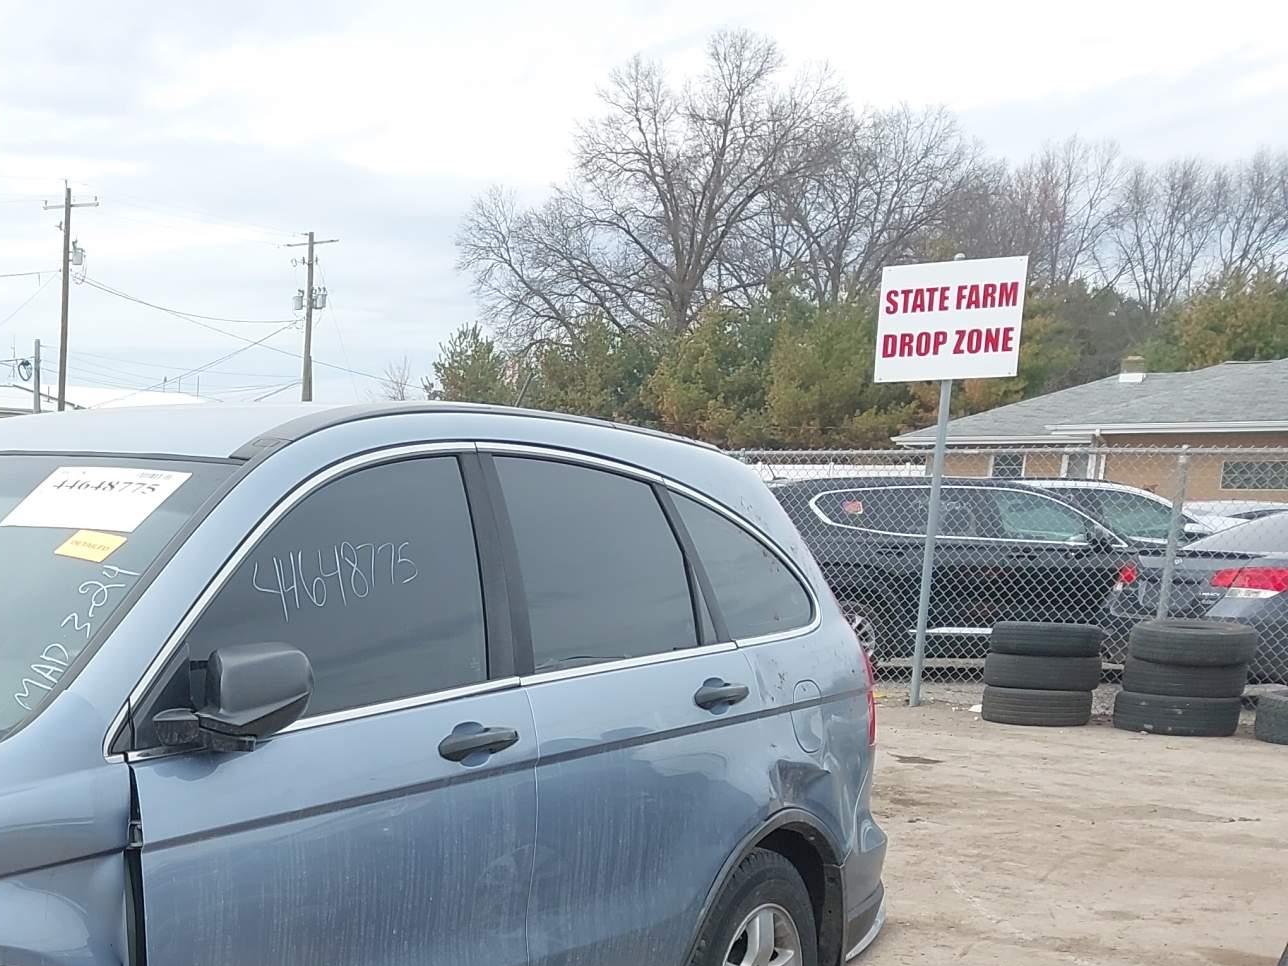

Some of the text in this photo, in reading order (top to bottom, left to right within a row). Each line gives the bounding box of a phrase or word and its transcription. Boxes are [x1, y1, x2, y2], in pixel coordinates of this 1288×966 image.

[885, 282, 1019, 315] STATE FARM
[882, 327, 1014, 358] DROP ZONE
[53, 479, 160, 495] 44648775
[252, 540, 419, 623] 44648775
[14, 643, 69, 711] MAD
